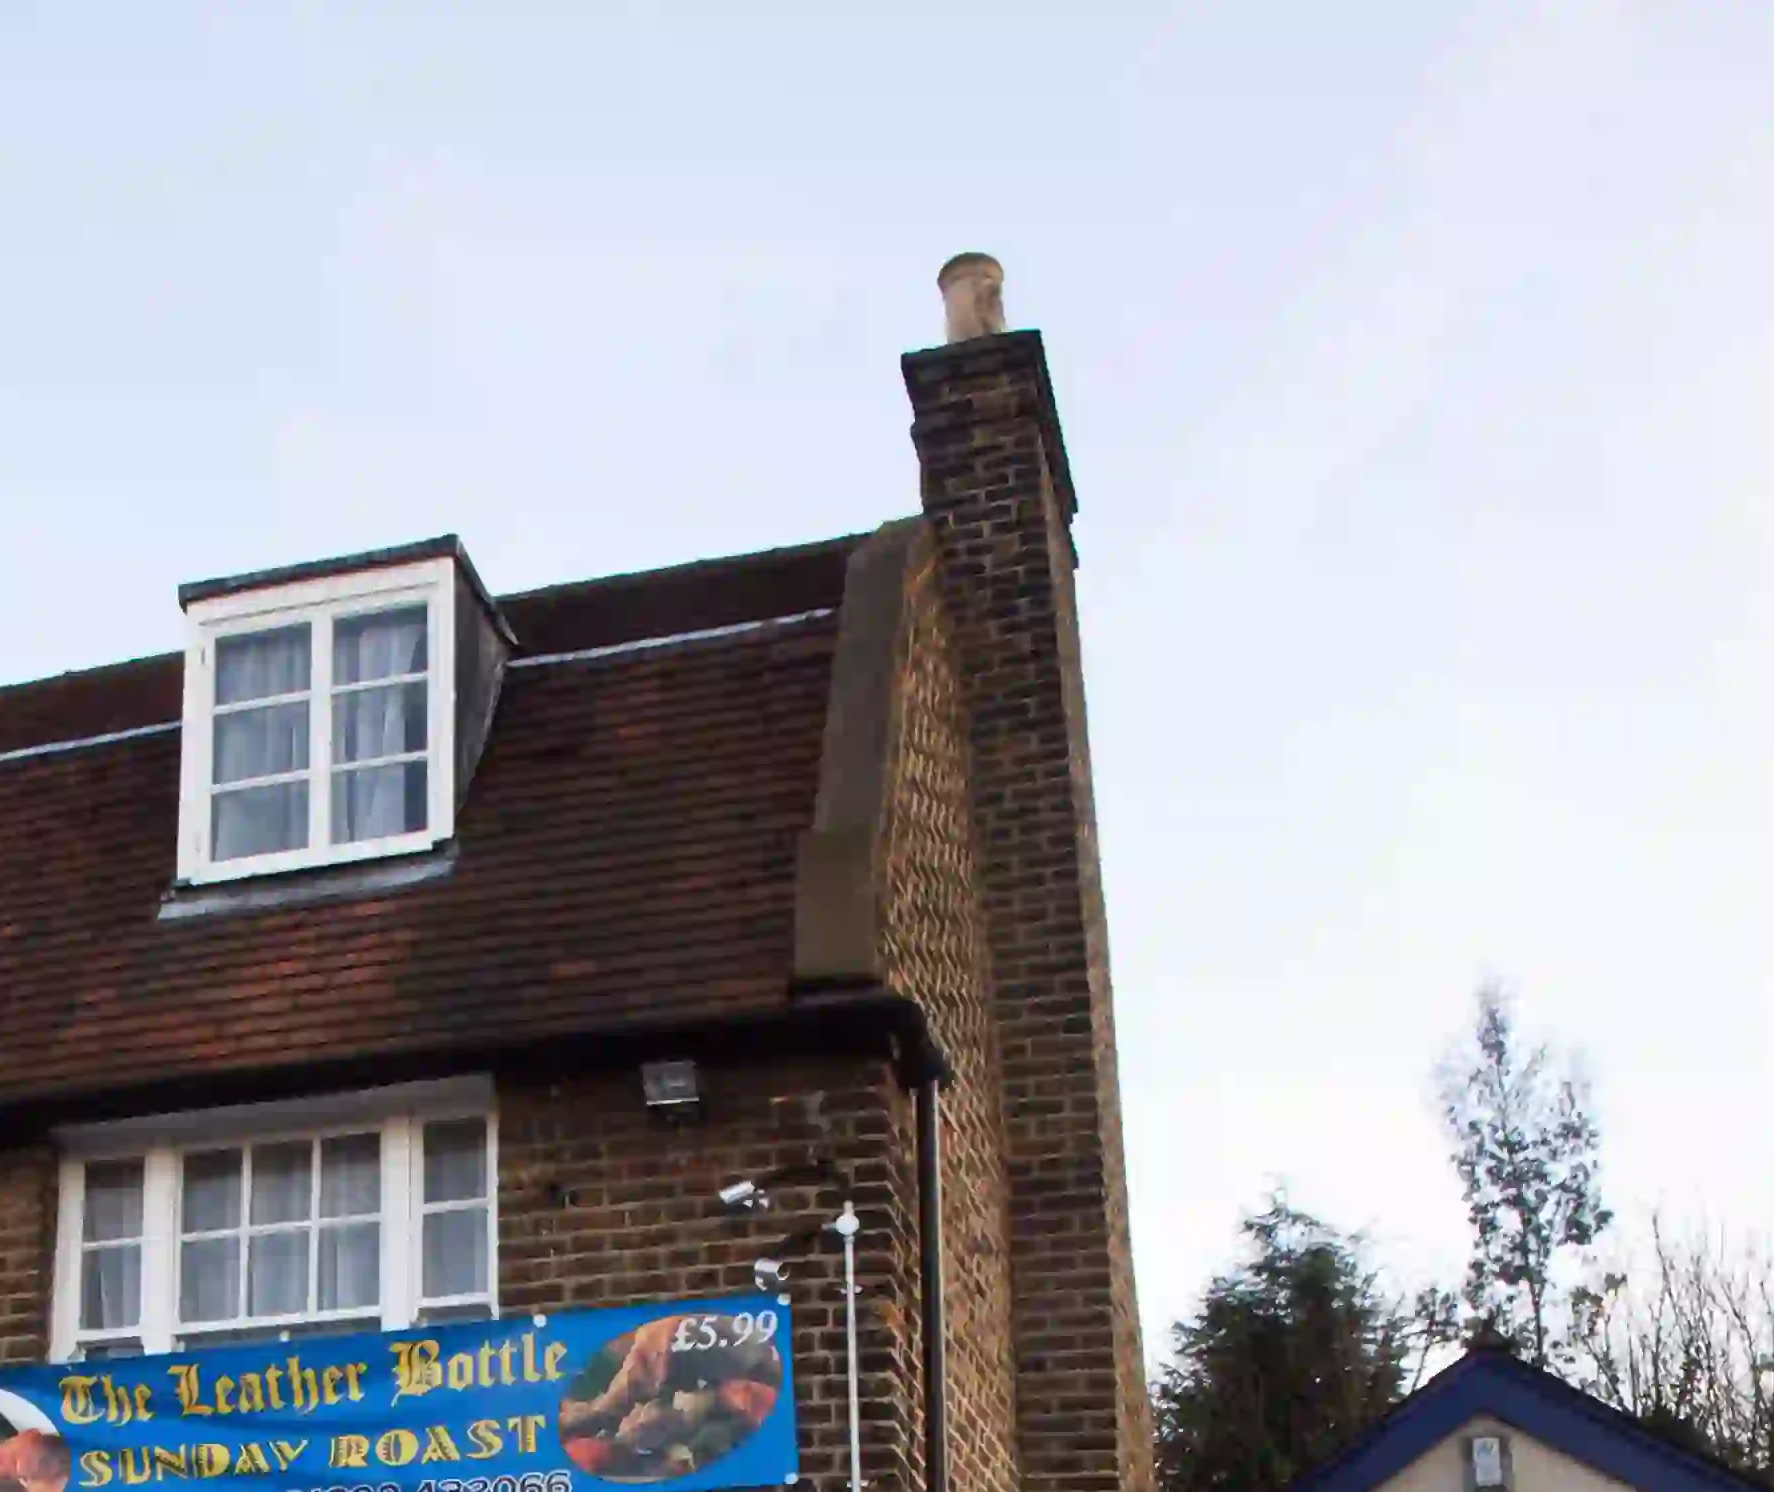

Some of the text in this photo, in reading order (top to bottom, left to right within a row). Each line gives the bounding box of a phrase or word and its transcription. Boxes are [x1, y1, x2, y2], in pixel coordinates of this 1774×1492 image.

[670, 1309, 778, 1352] £5.99
[59, 1331, 568, 1426] The Leather Bottle
[78, 1415, 547, 1488] SUNDAY ROAST
